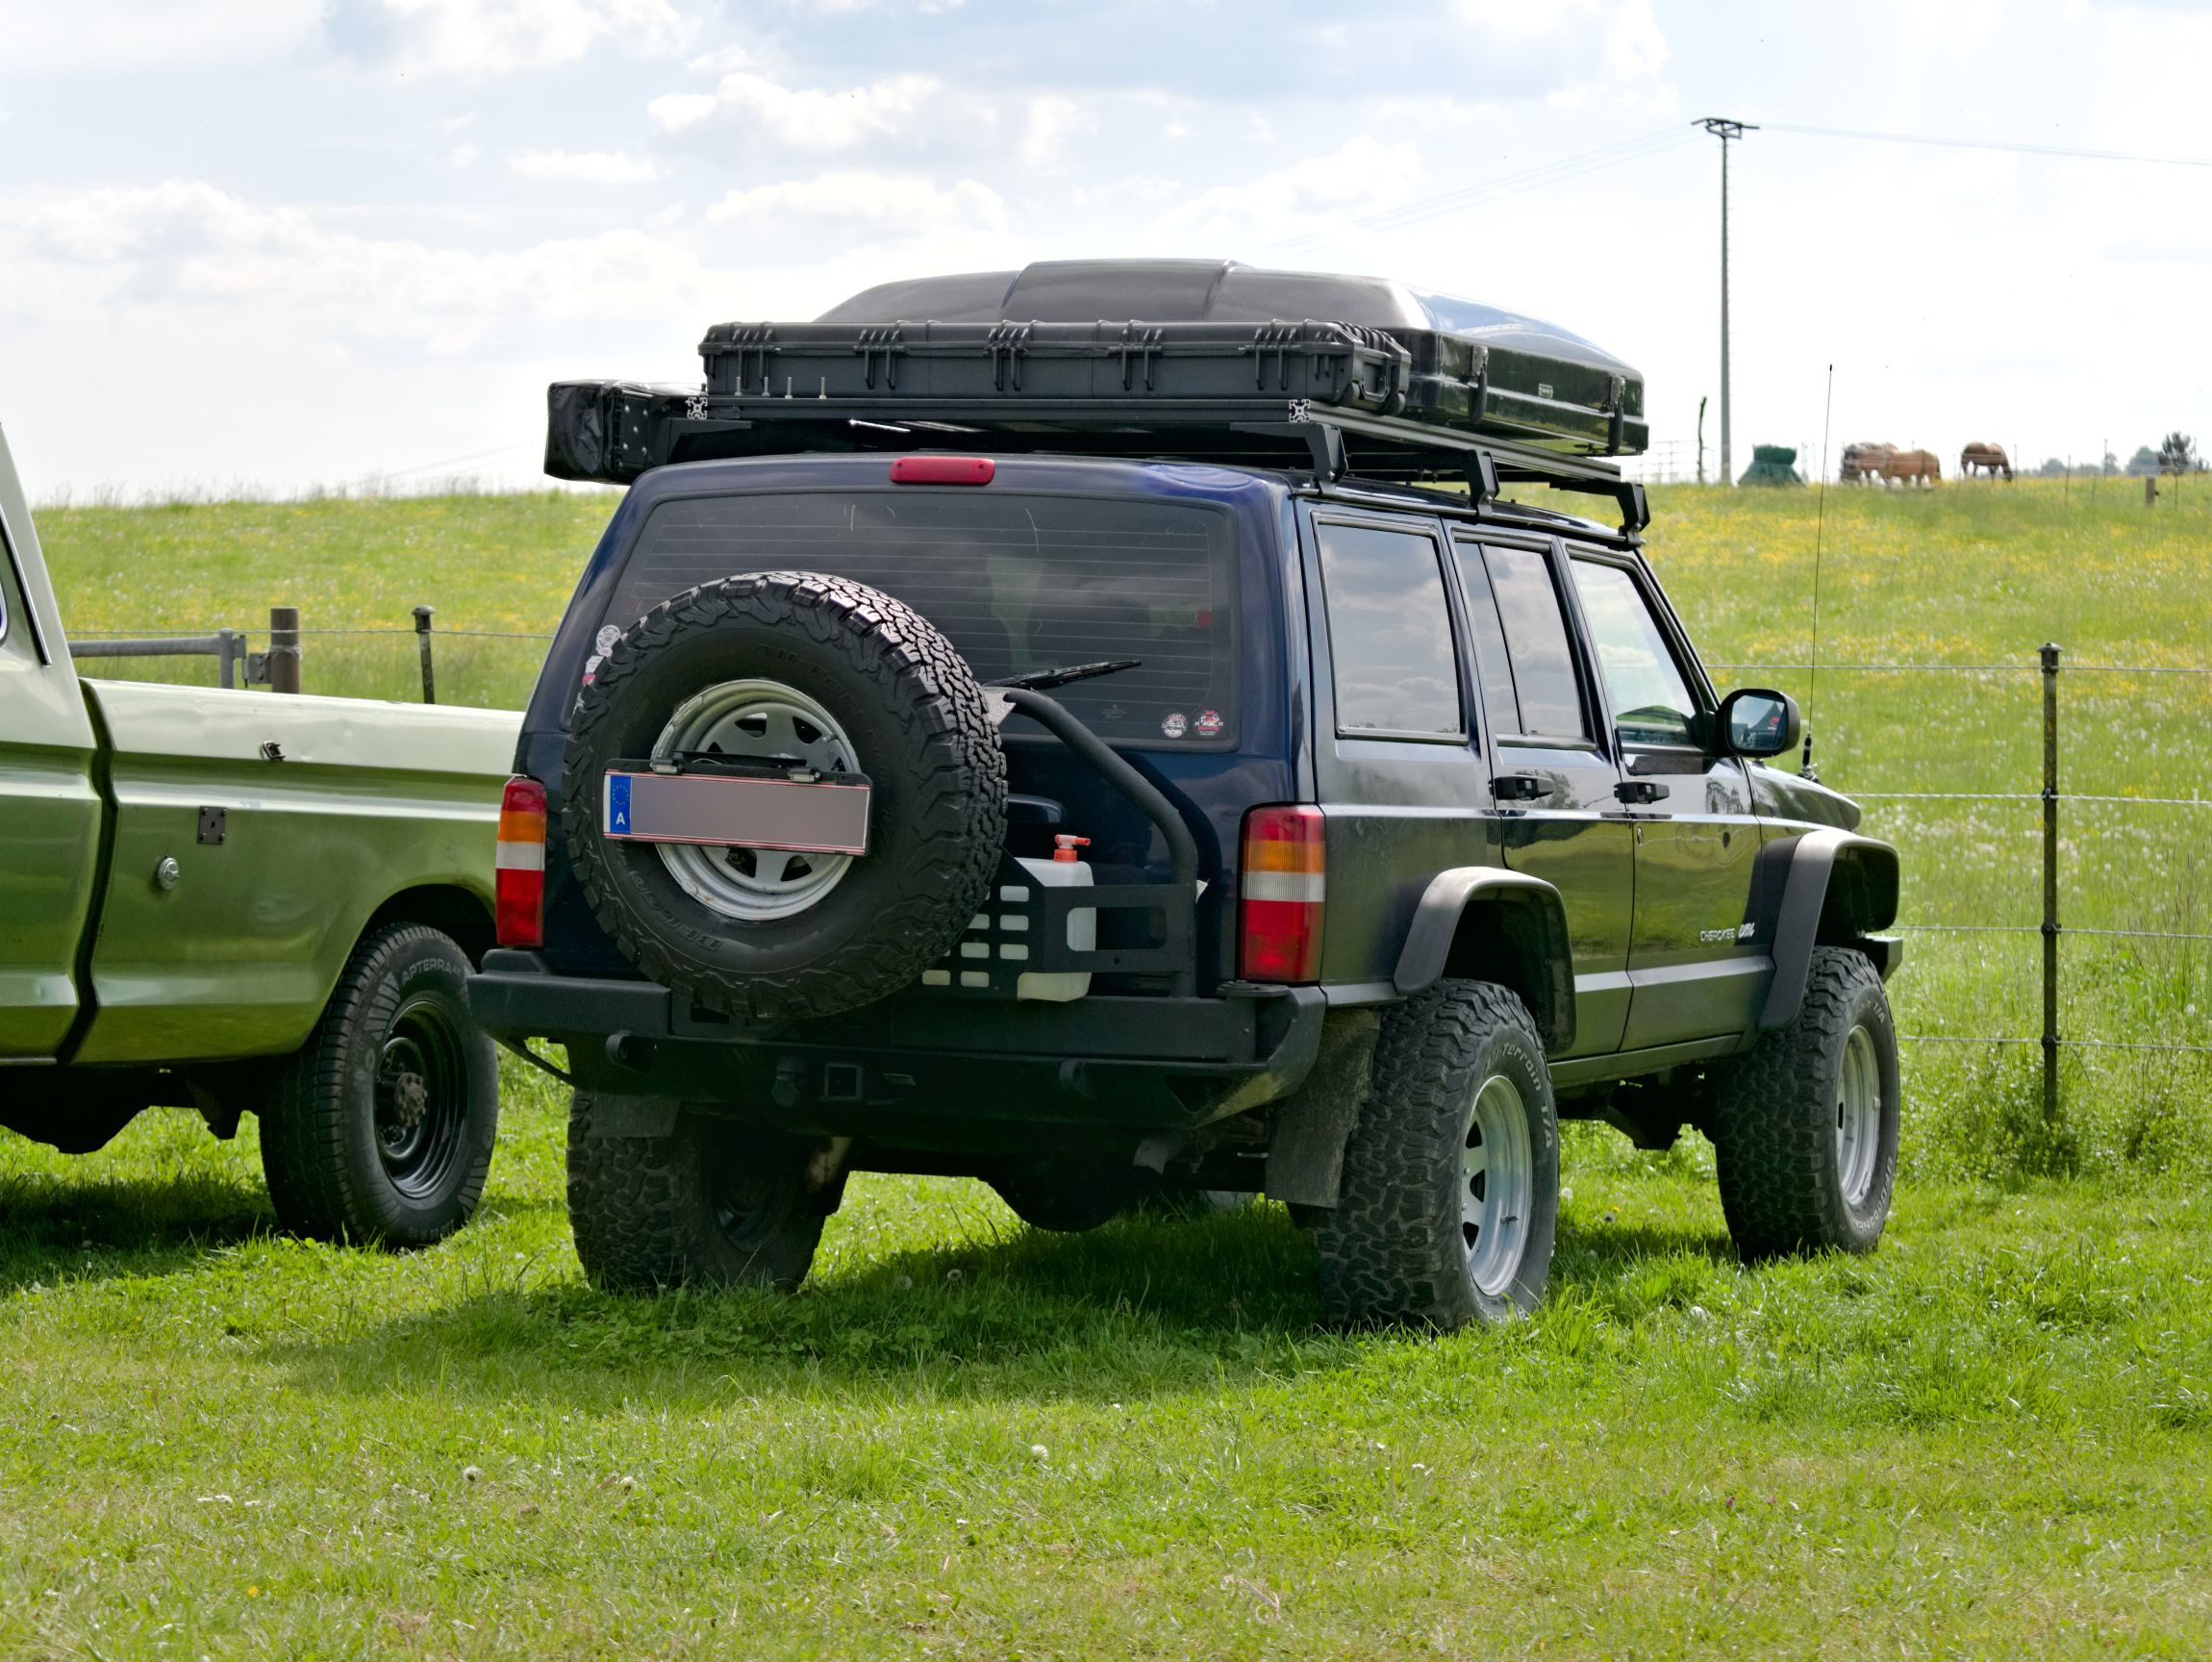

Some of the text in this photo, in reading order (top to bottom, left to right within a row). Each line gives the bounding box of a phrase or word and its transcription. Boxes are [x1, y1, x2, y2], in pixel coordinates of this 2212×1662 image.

[616, 812, 625, 825] A
[1699, 927, 1735, 942] CHEROKEE
[1541, 1100, 1553, 1148] T/A
